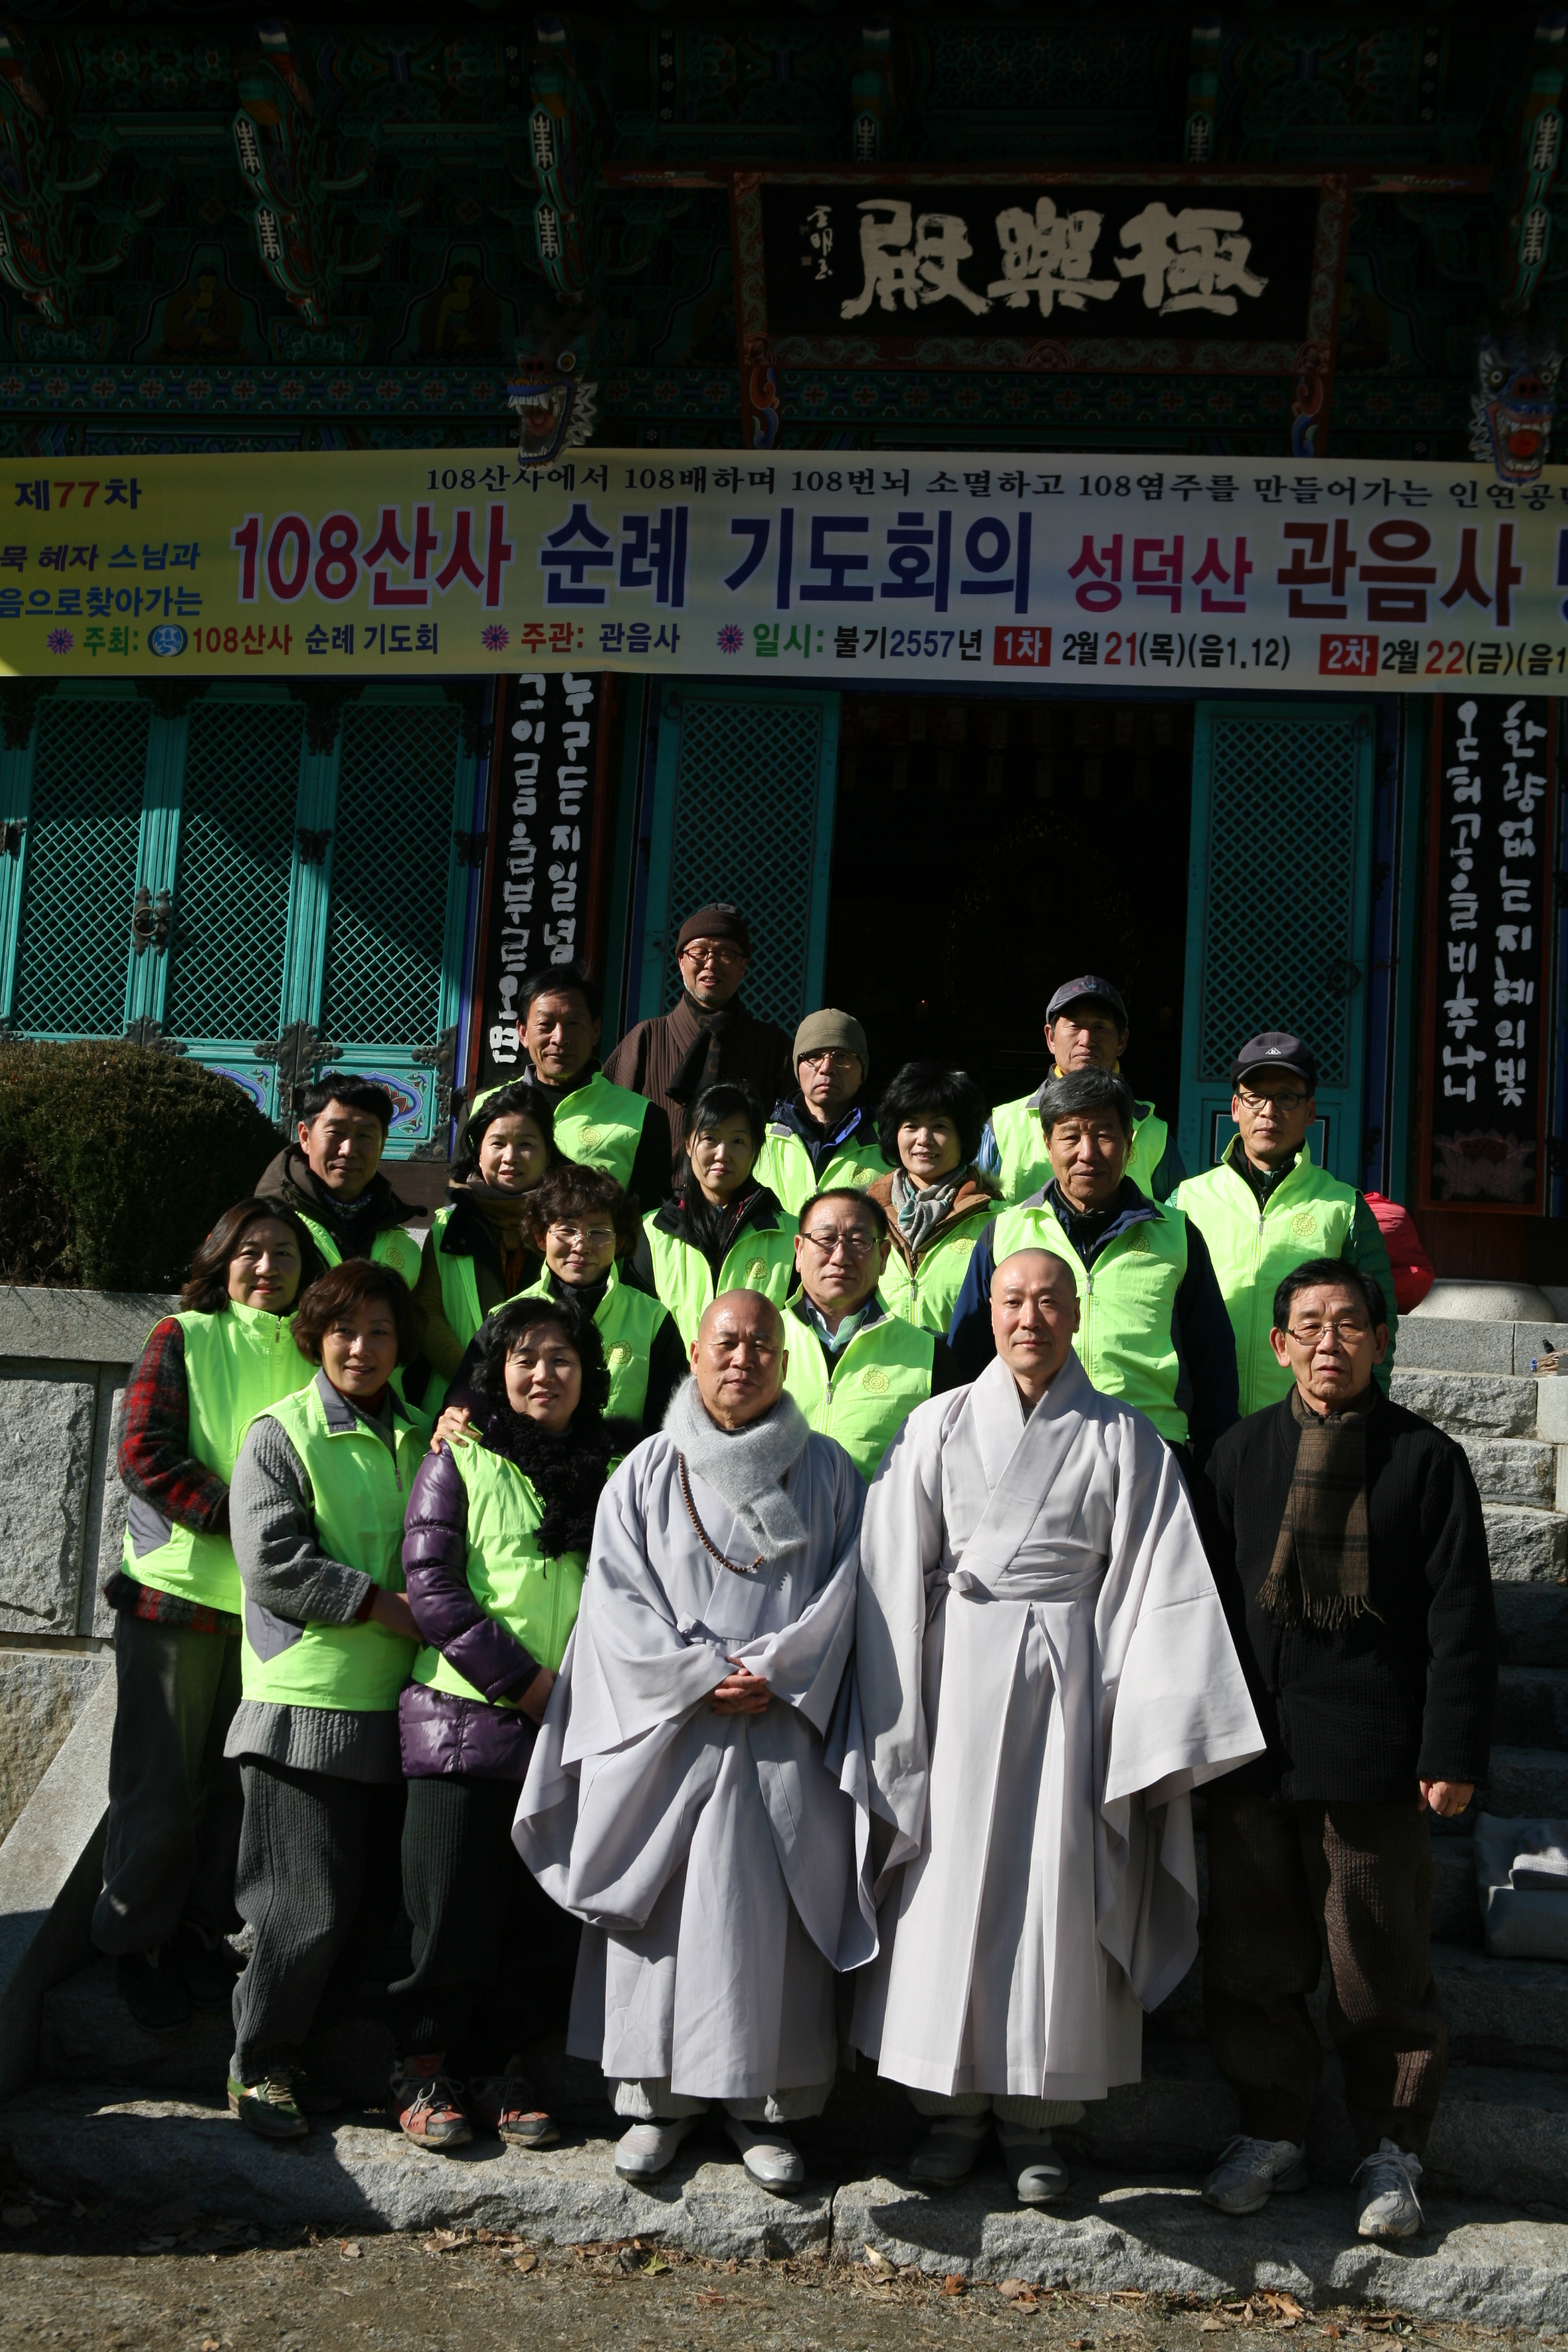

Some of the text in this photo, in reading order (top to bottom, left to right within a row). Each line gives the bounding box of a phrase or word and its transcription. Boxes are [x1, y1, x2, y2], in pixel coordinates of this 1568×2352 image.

[15, 477, 142, 511] 제77차
[426, 464, 609, 493] 108산사에서
[624, 466, 776, 494] 108배하며
[791, 468, 909, 497] 108번뇌
[926, 469, 1065, 499] 소멸하고
[1078, 473, 1240, 503] 108염주를
[1253, 474, 1434, 508] 만들어가는
[39, 543, 99, 572] 혜자
[108, 542, 201, 570] 스님과
[235, 501, 512, 607] 108산사
[540, 503, 688, 608] 순례
[724, 508, 1032, 614] 기도회의
[1067, 533, 1253, 614] 성덕산
[1277, 517, 1522, 627] 관음사
[83, 623, 439, 657] 주최: 108산사 순례 기도회
[521, 622, 680, 654] 주관: 관음사
[753, 624, 824, 659] 일시:
[1004, 627, 1043, 661] 1차
[1327, 633, 1370, 670] 2차
